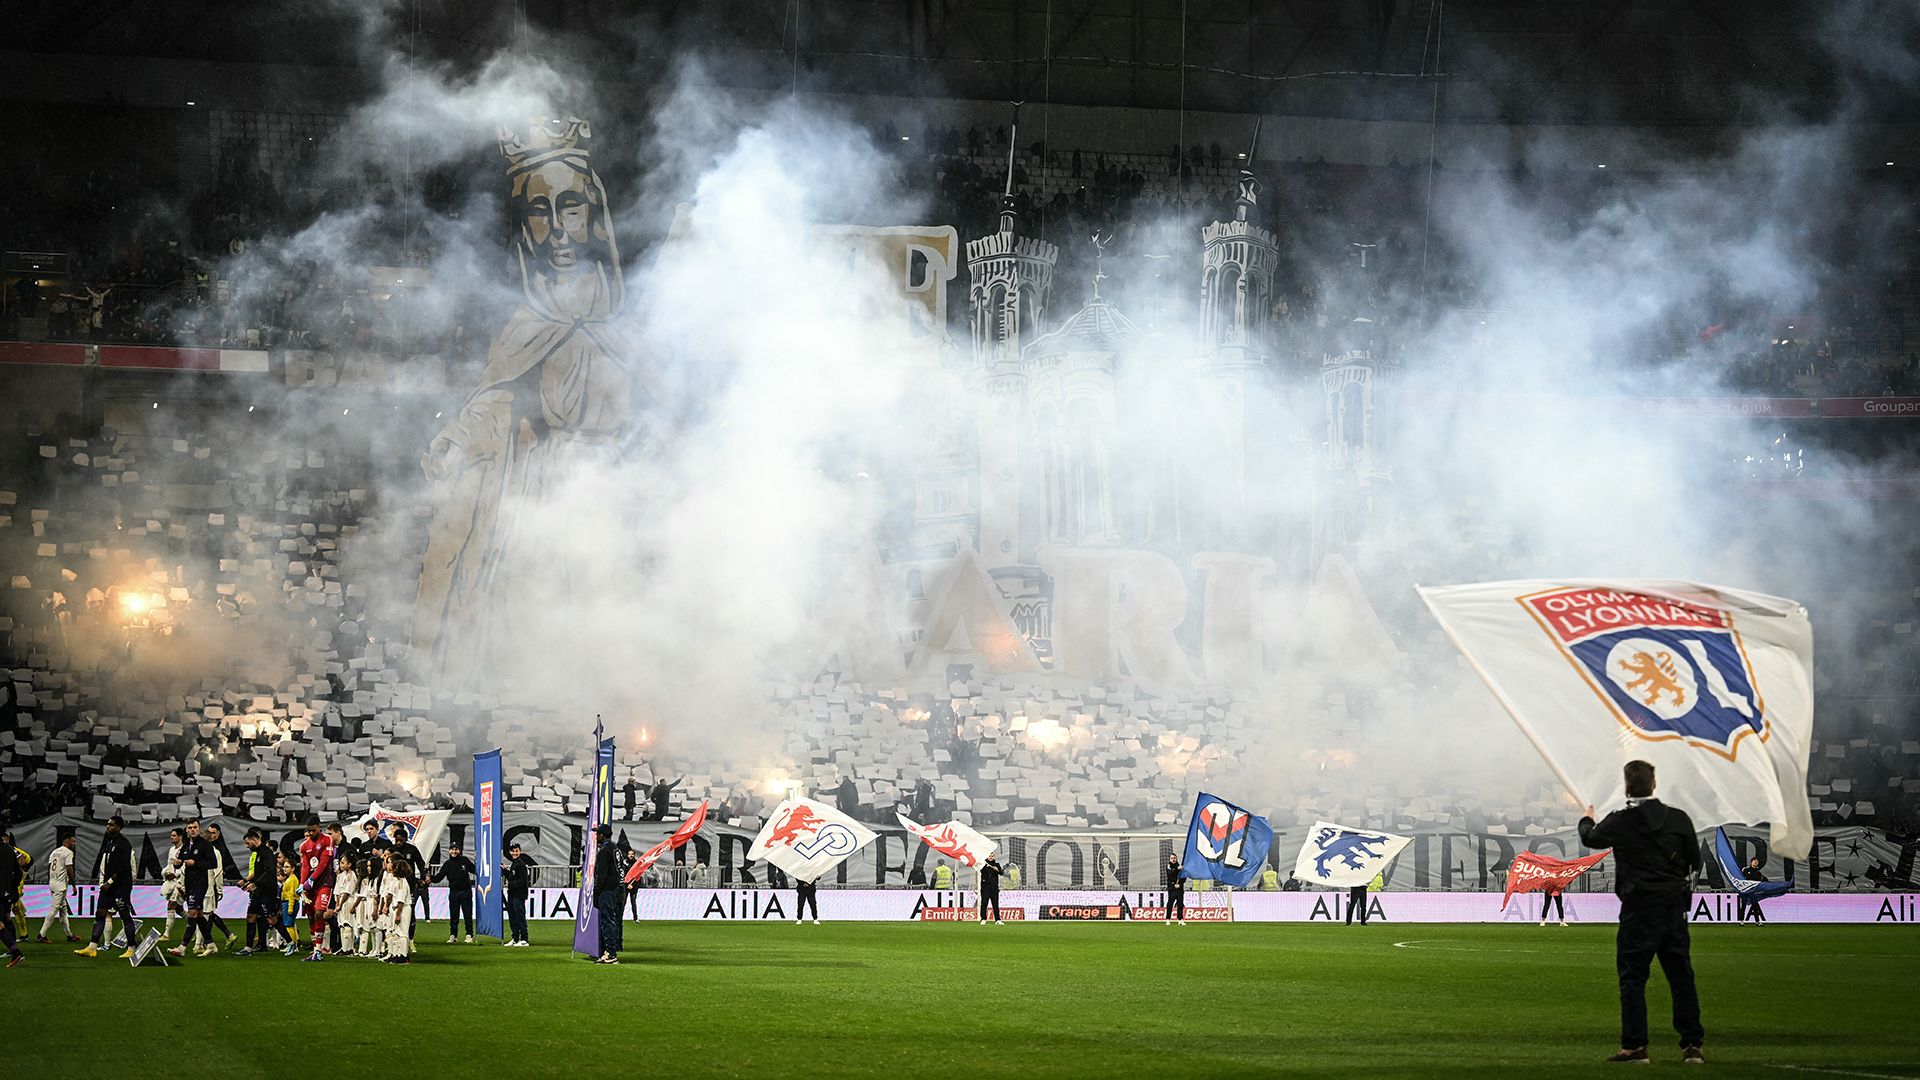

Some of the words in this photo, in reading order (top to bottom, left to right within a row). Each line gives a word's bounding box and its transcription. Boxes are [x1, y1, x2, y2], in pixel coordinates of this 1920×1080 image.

[1049, 906, 1100, 920] Orange
[1134, 908, 1178, 920] Betclc
[1185, 908, 1229, 920] Betclic
